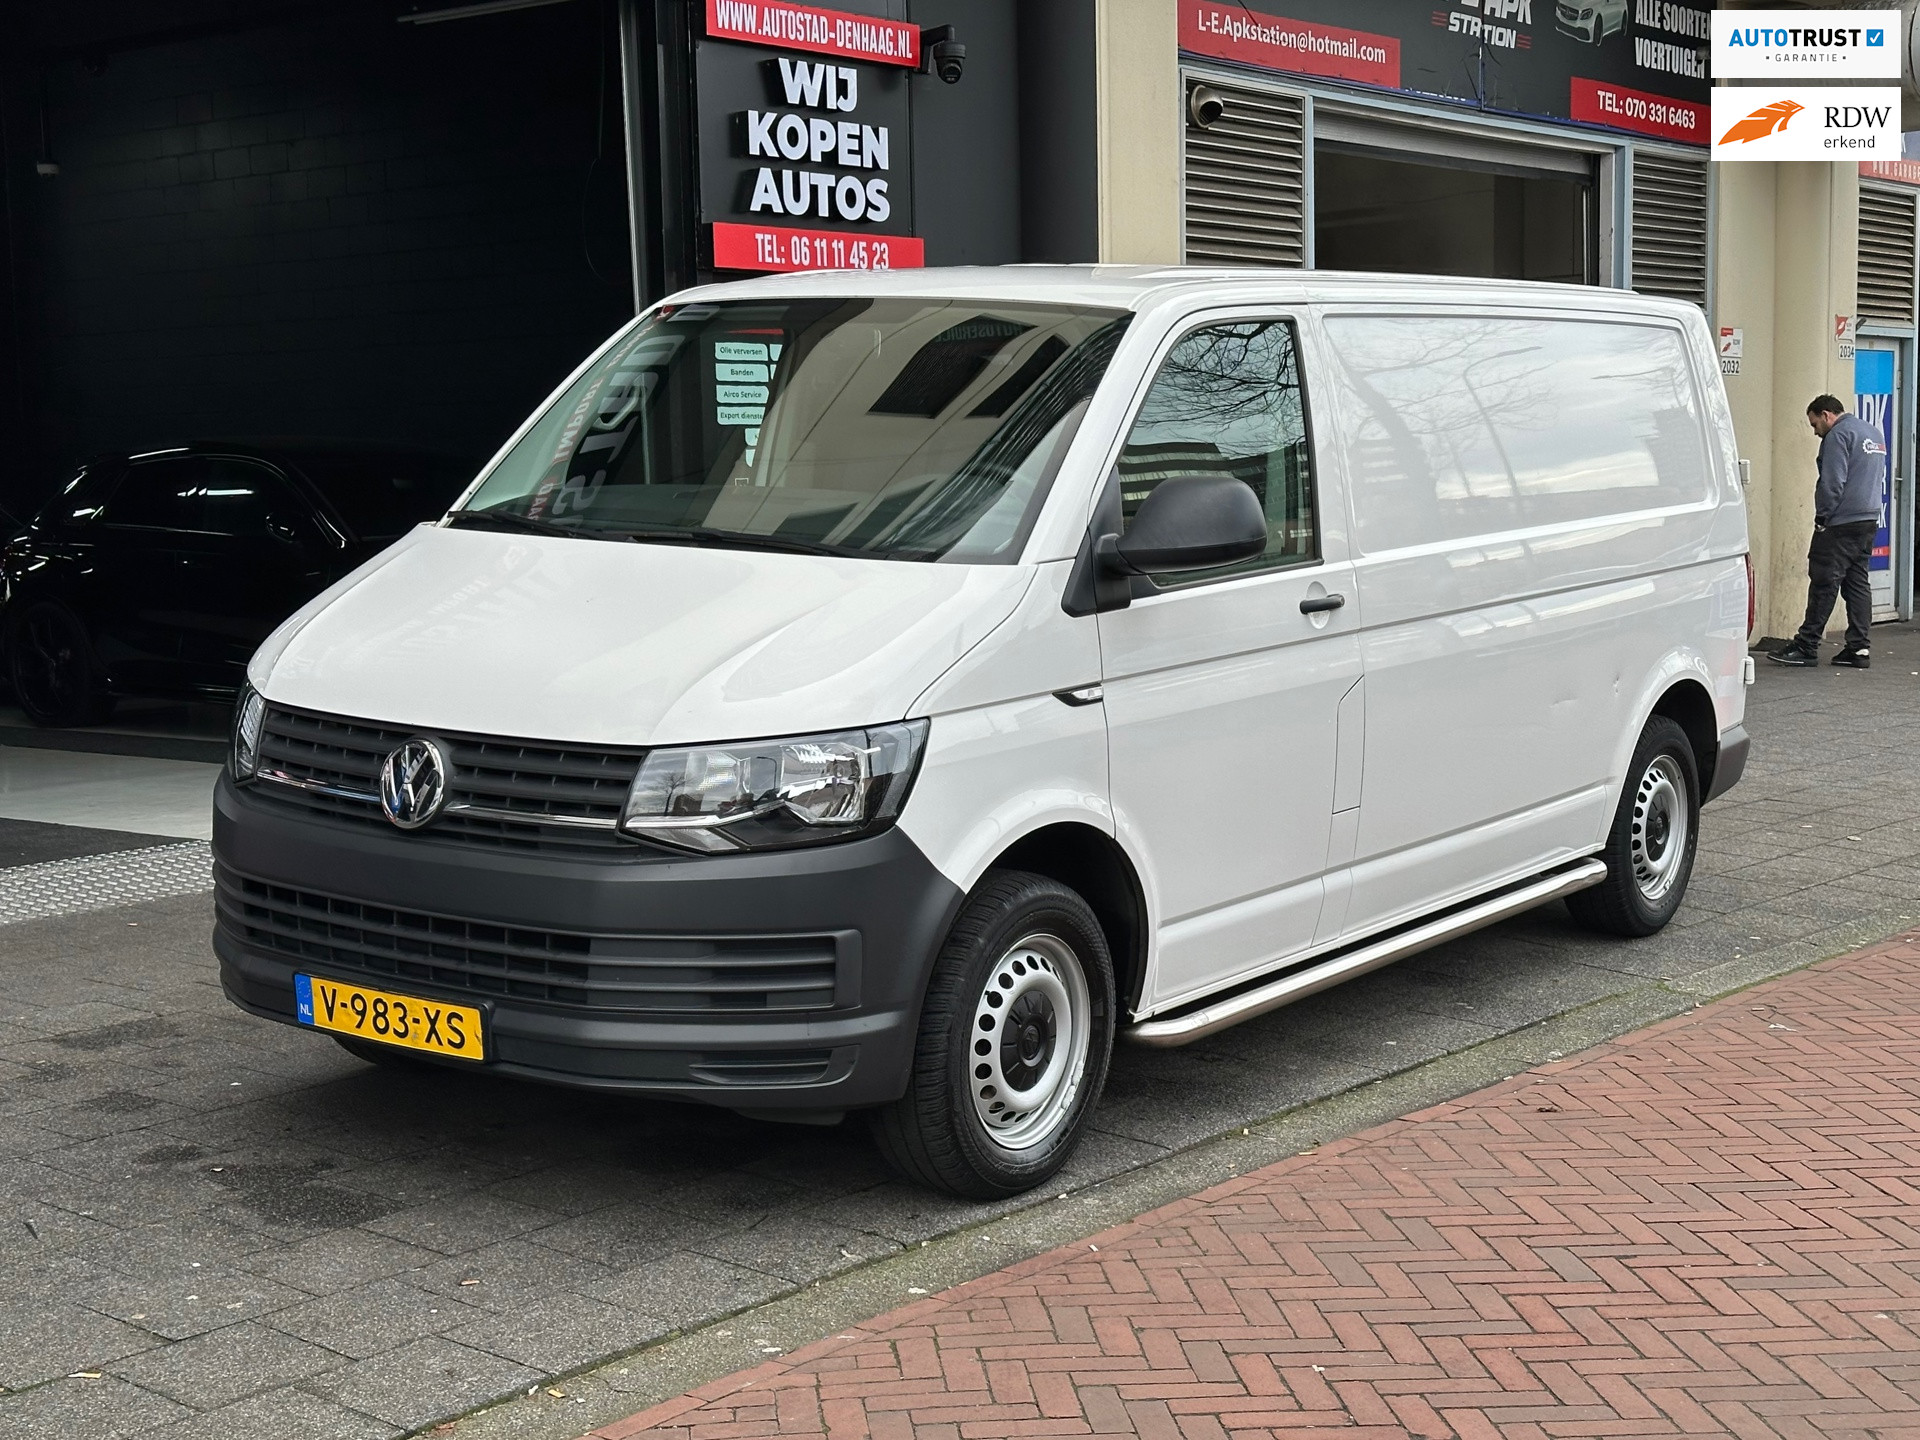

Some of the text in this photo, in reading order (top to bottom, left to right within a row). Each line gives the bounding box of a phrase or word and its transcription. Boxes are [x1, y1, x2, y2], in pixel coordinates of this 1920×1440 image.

[715, 0, 913, 59] WWW.AUTOSTAD-DENHAAG.NL
[1448, 11, 1516, 49] STATION
[1635, 0, 1661, 28] ALLE
[1197, 9, 1386, 64] L-E.Apkstation@hotmail.com
[778, 57, 858, 112] WIJ
[1597, 90, 1696, 130] TEL: 070 331 6463
[748, 109, 889, 170] KOPEN
[750, 167, 891, 222] AUTOS
[755, 233, 889, 270] TEL: 06 11 11 45 23
[733, 348, 763, 356] verversen
[1722, 360, 1740, 374] 2032
[730, 368, 754, 376] Banden
[740, 391, 762, 399] Service
[720, 412, 740, 420] Export
[300, 1002, 313, 1017] NL
[319, 985, 466, 1050] V-983-XS
